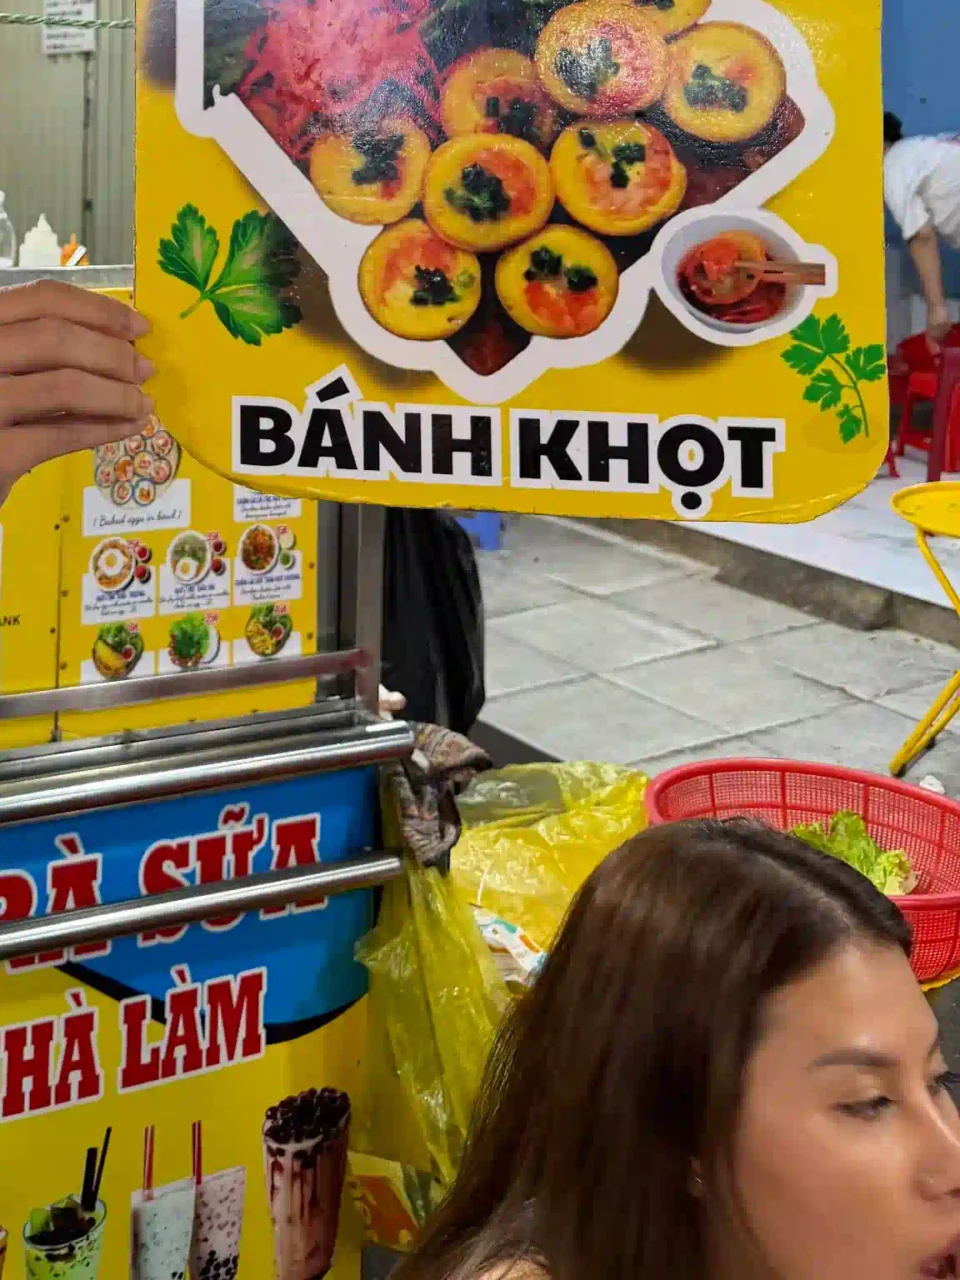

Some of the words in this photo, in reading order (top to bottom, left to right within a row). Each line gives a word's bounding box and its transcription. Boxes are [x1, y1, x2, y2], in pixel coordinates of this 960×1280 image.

[238, 376, 493, 477] BÁNH
[517, 417, 777, 511] KHỌT
[139, 804, 330, 942] SỮA
[119, 966, 266, 1090] LÀM
